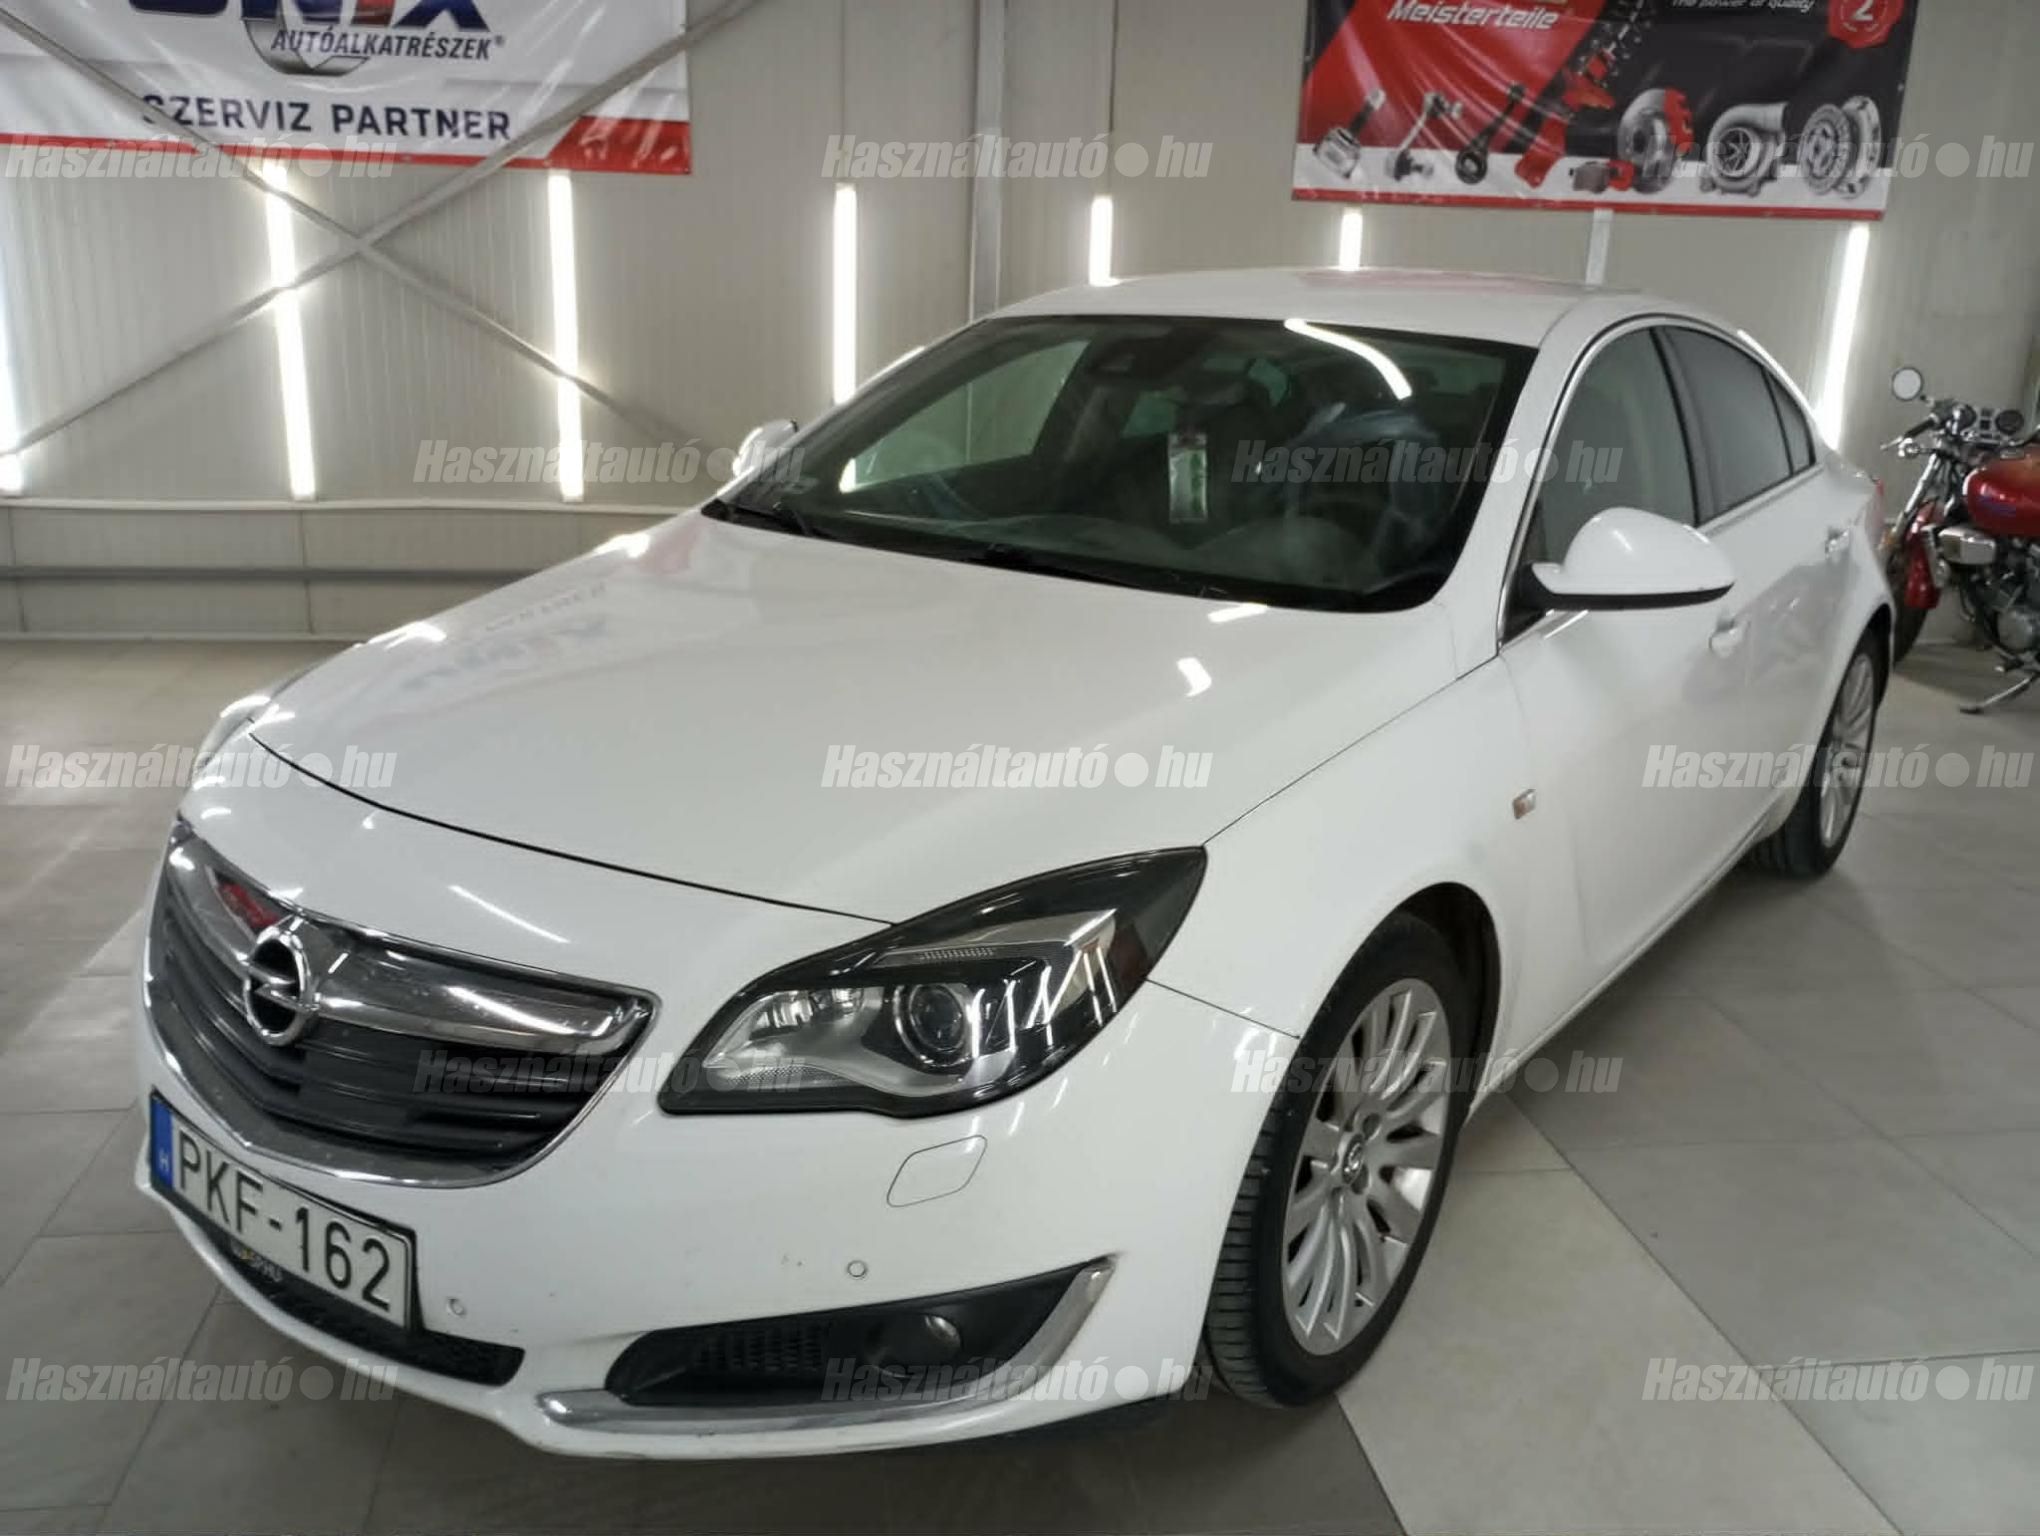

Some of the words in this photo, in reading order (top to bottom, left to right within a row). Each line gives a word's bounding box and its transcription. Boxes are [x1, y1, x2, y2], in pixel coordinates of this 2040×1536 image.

[1386, 0, 1559, 30] Meisterteile
[331, 104, 512, 140] PARTNER
[178, 1129, 391, 1312] PKF-162
